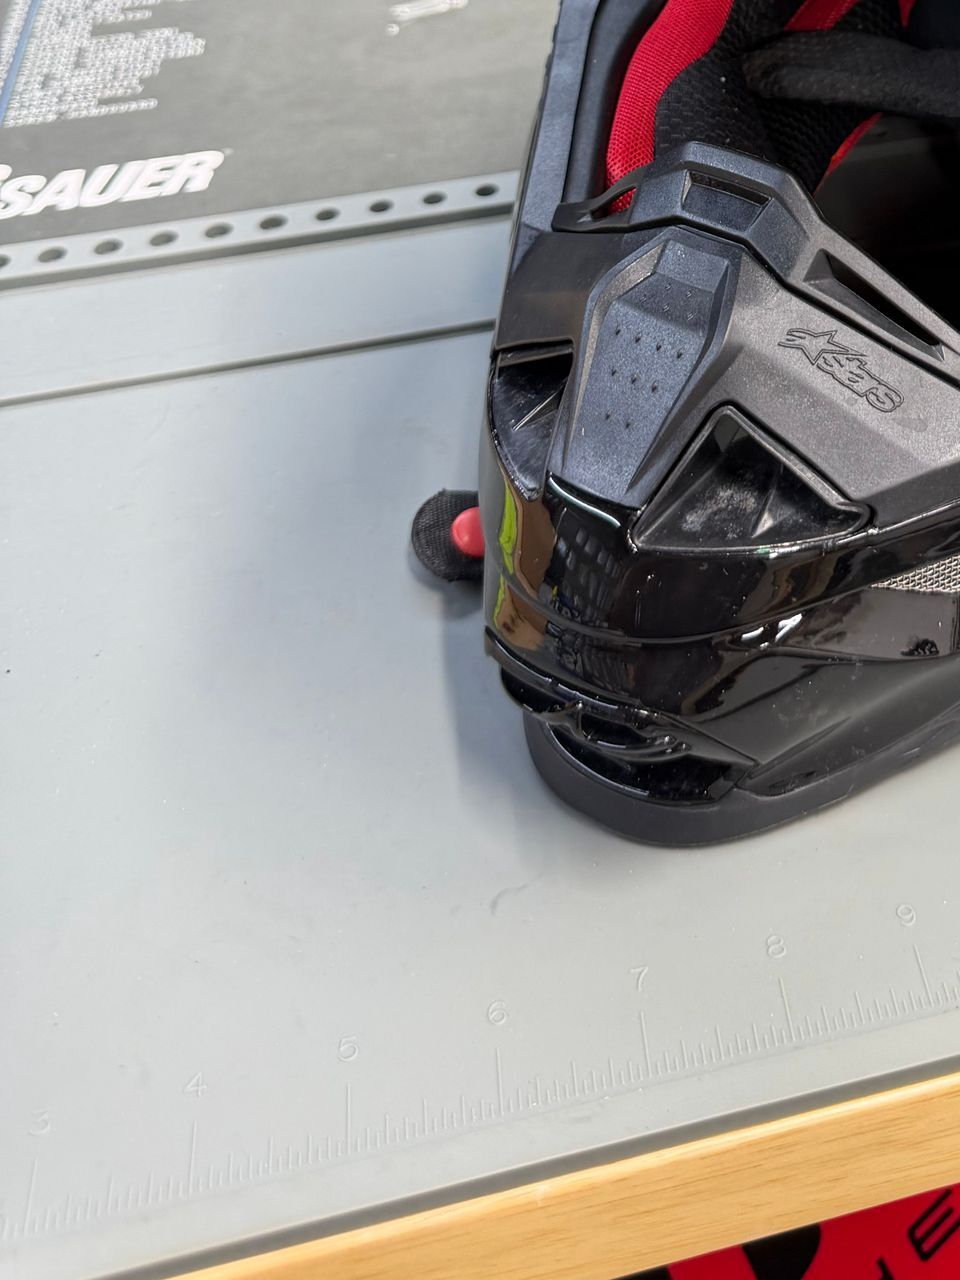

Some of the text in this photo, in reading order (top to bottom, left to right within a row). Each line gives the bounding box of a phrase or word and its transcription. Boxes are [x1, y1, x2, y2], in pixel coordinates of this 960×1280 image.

[0, 150, 225, 220] SAUER
[28, 1108, 51, 1136] 3
[182, 1071, 207, 1098] 4
[337, 1035, 359, 1062] 5
[487, 1000, 508, 1025] 6
[628, 966, 649, 992] 7
[765, 934, 788, 959] 8
[896, 904, 916, 926] 9
